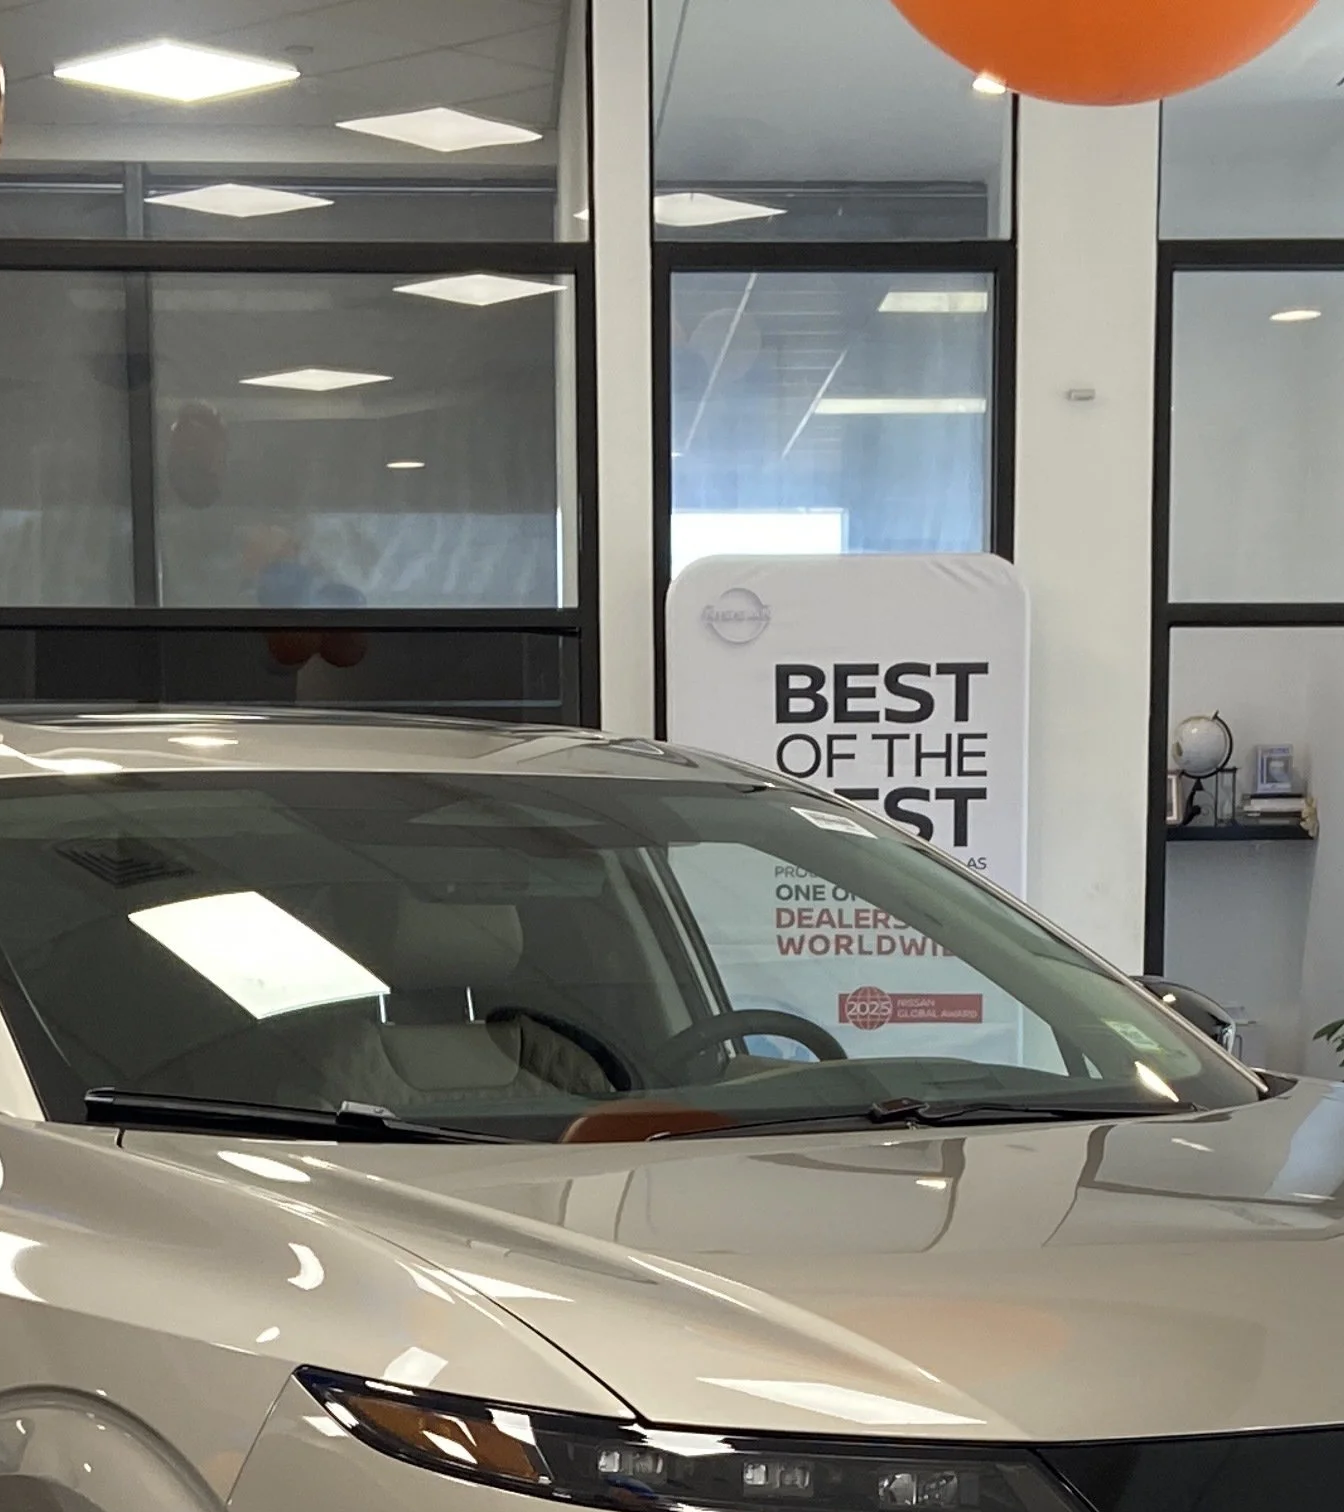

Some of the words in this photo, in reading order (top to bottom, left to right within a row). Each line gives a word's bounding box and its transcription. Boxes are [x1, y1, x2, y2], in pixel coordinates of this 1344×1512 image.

[775, 662, 989, 724] BEST
[776, 733, 857, 778] OF
[871, 733, 988, 777] THE
[833, 787, 987, 848] ST
[776, 885, 826, 901] ONE
[777, 935, 956, 957] WORLDWI
[847, 1001, 892, 1017] 2025
